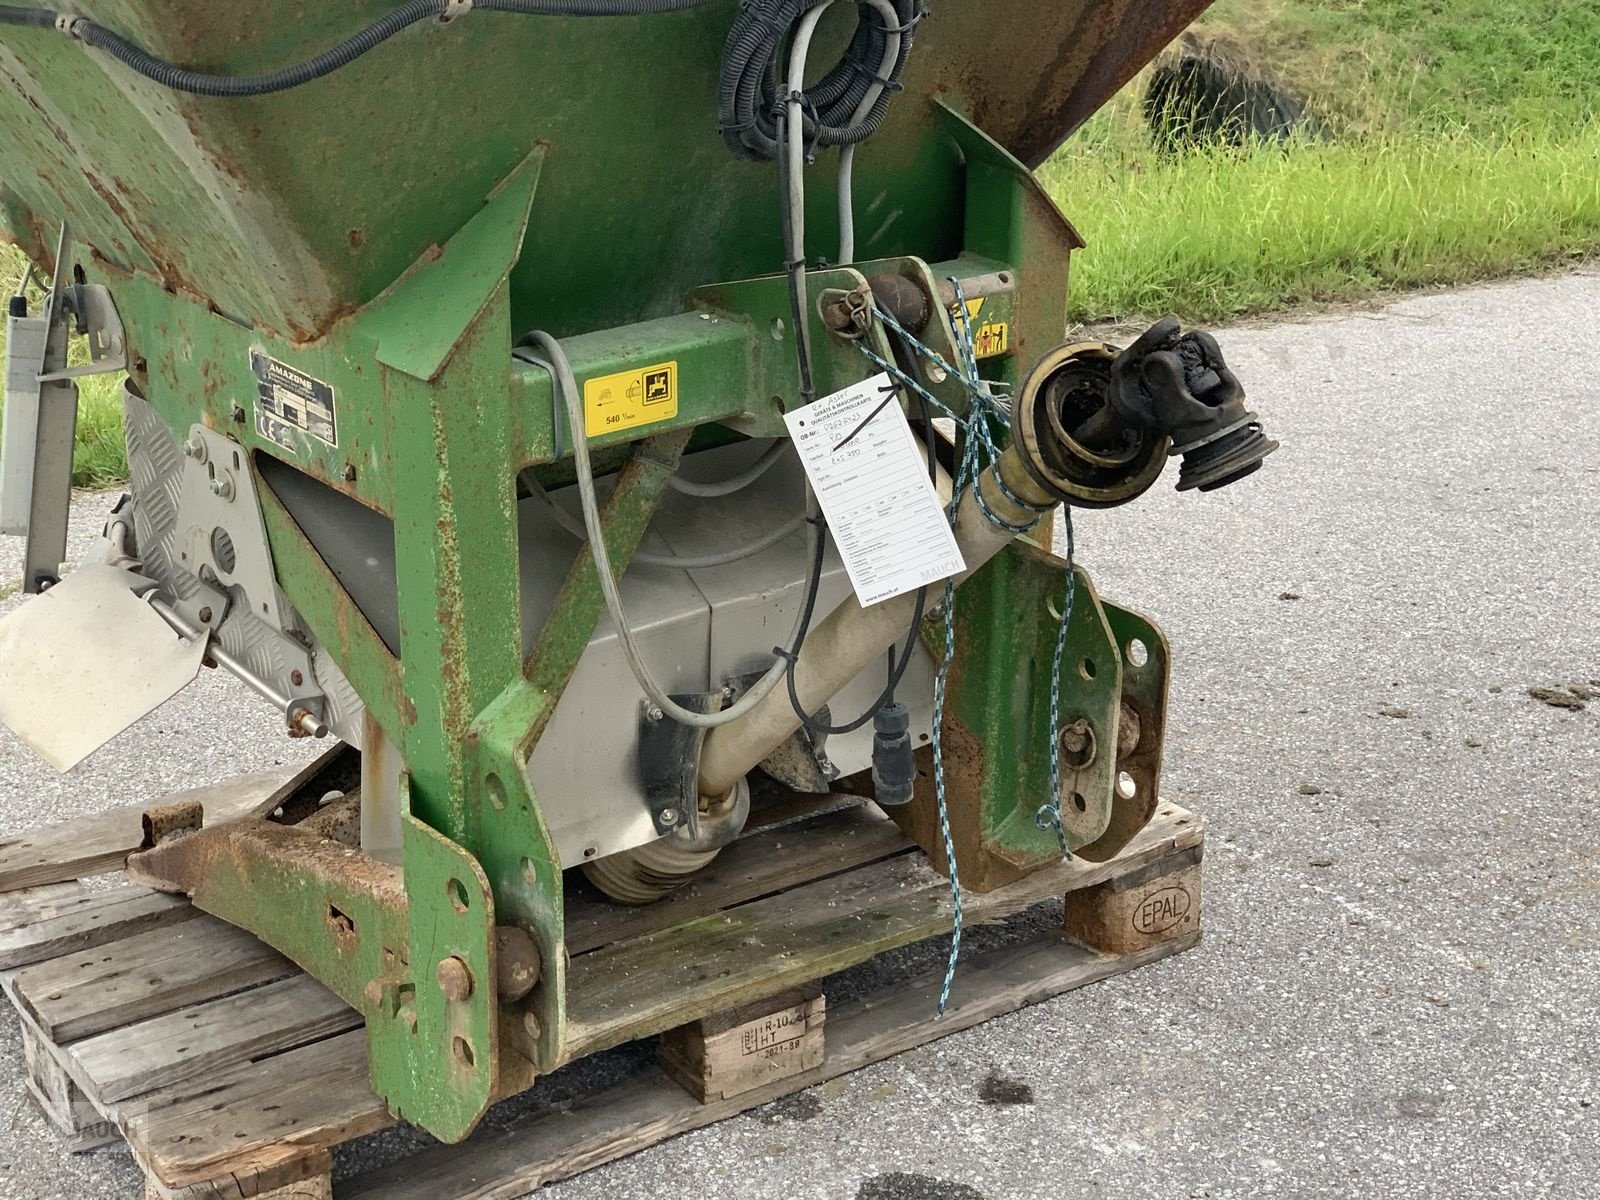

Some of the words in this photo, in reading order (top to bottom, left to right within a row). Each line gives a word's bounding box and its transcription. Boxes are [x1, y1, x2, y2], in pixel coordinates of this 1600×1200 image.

[269, 363, 313, 390] AMAZONE
[836, 393, 864, 408] MASCHINEN
[606, 415, 620, 425] 540
[920, 559, 960, 583] MAUCH
[864, 586, 900, 603] www.mauch.at
[1142, 894, 1182, 928] EPAL
[760, 1031, 776, 1046] HT
